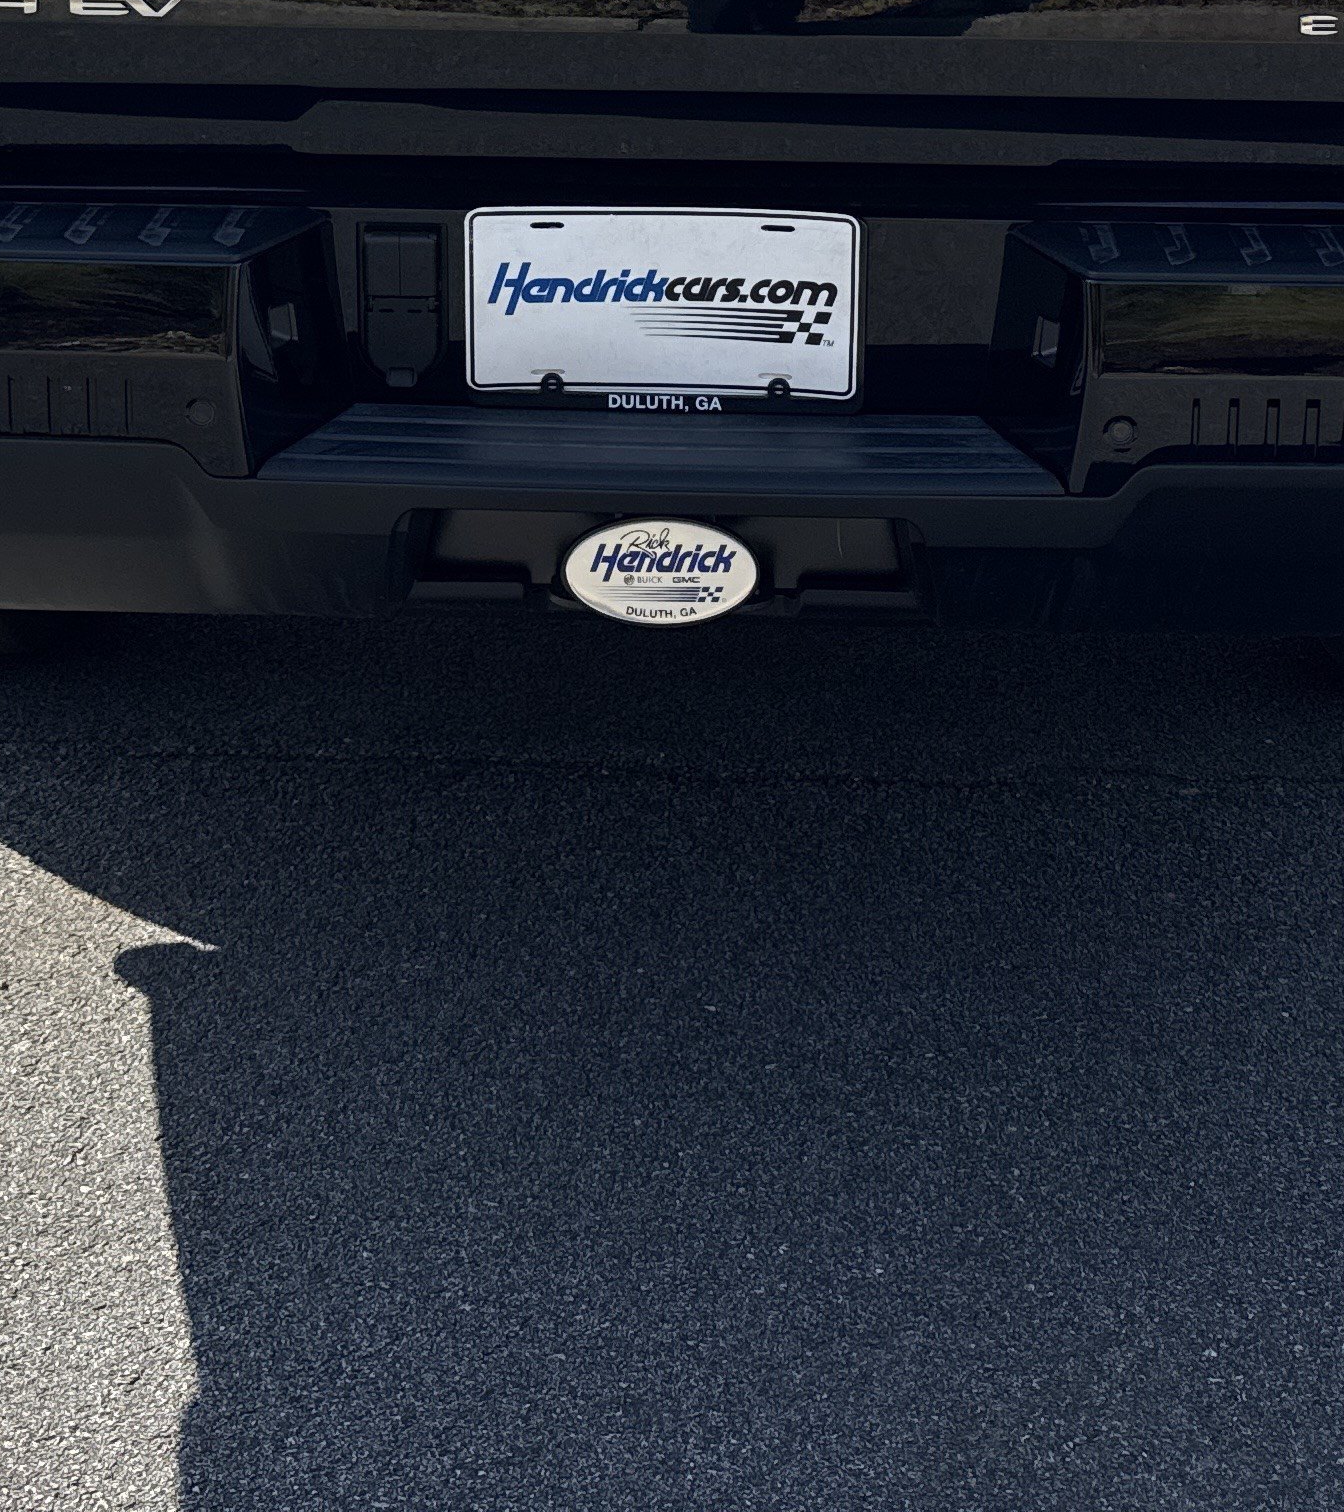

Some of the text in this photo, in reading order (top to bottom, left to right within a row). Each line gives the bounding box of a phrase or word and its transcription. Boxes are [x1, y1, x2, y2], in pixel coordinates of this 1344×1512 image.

[487, 262, 838, 315] Hendrickcars.com
[608, 393, 722, 412] DULUTH, GA
[620, 528, 672, 558] Rick
[590, 544, 737, 582] Hendrick
[637, 575, 701, 584] BUICK GMC
[625, 606, 698, 619] DULUTH, GA
